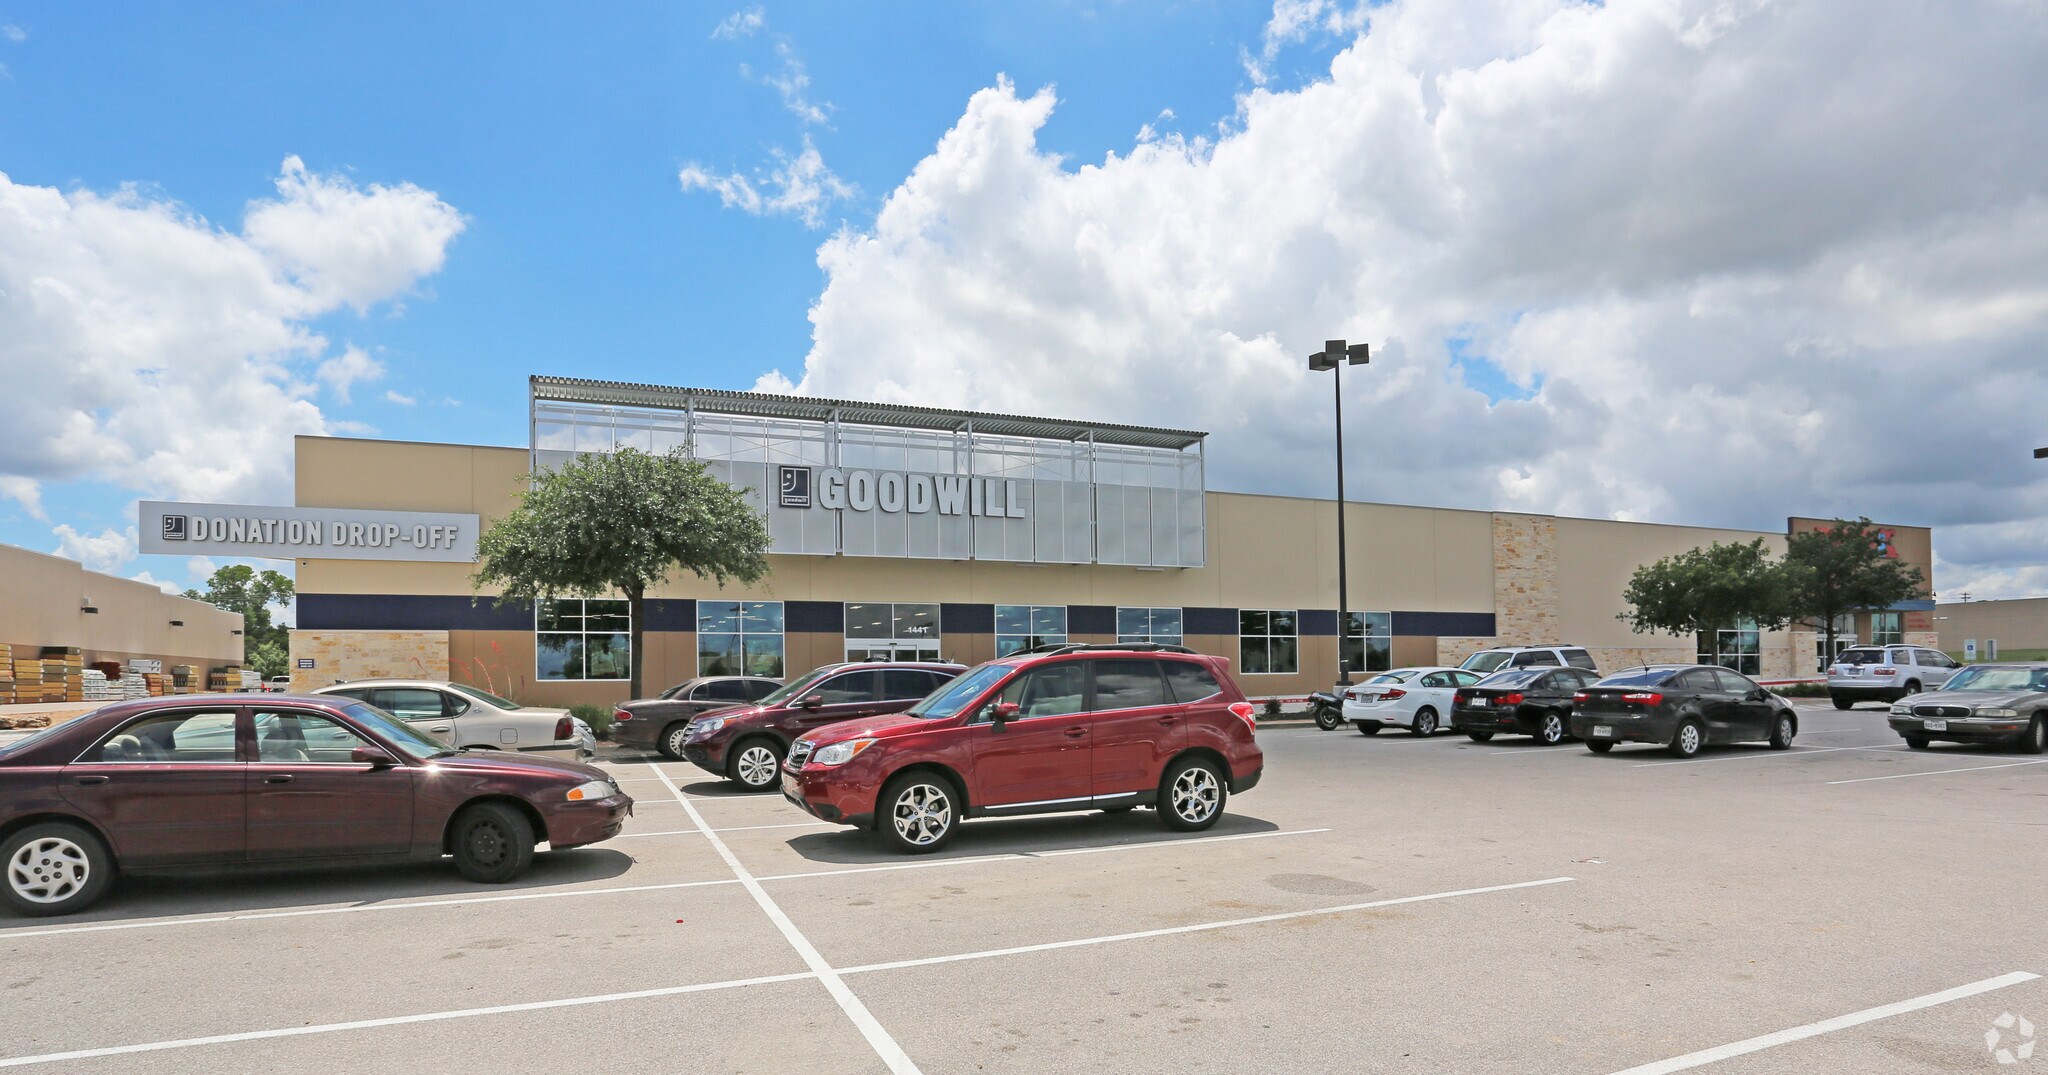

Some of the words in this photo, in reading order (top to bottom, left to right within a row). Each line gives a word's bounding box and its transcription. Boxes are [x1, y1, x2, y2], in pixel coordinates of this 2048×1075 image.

[818, 468, 1026, 518] GOODWILL
[191, 516, 323, 546] DONATION
[331, 521, 459, 549] DROP-OFF
